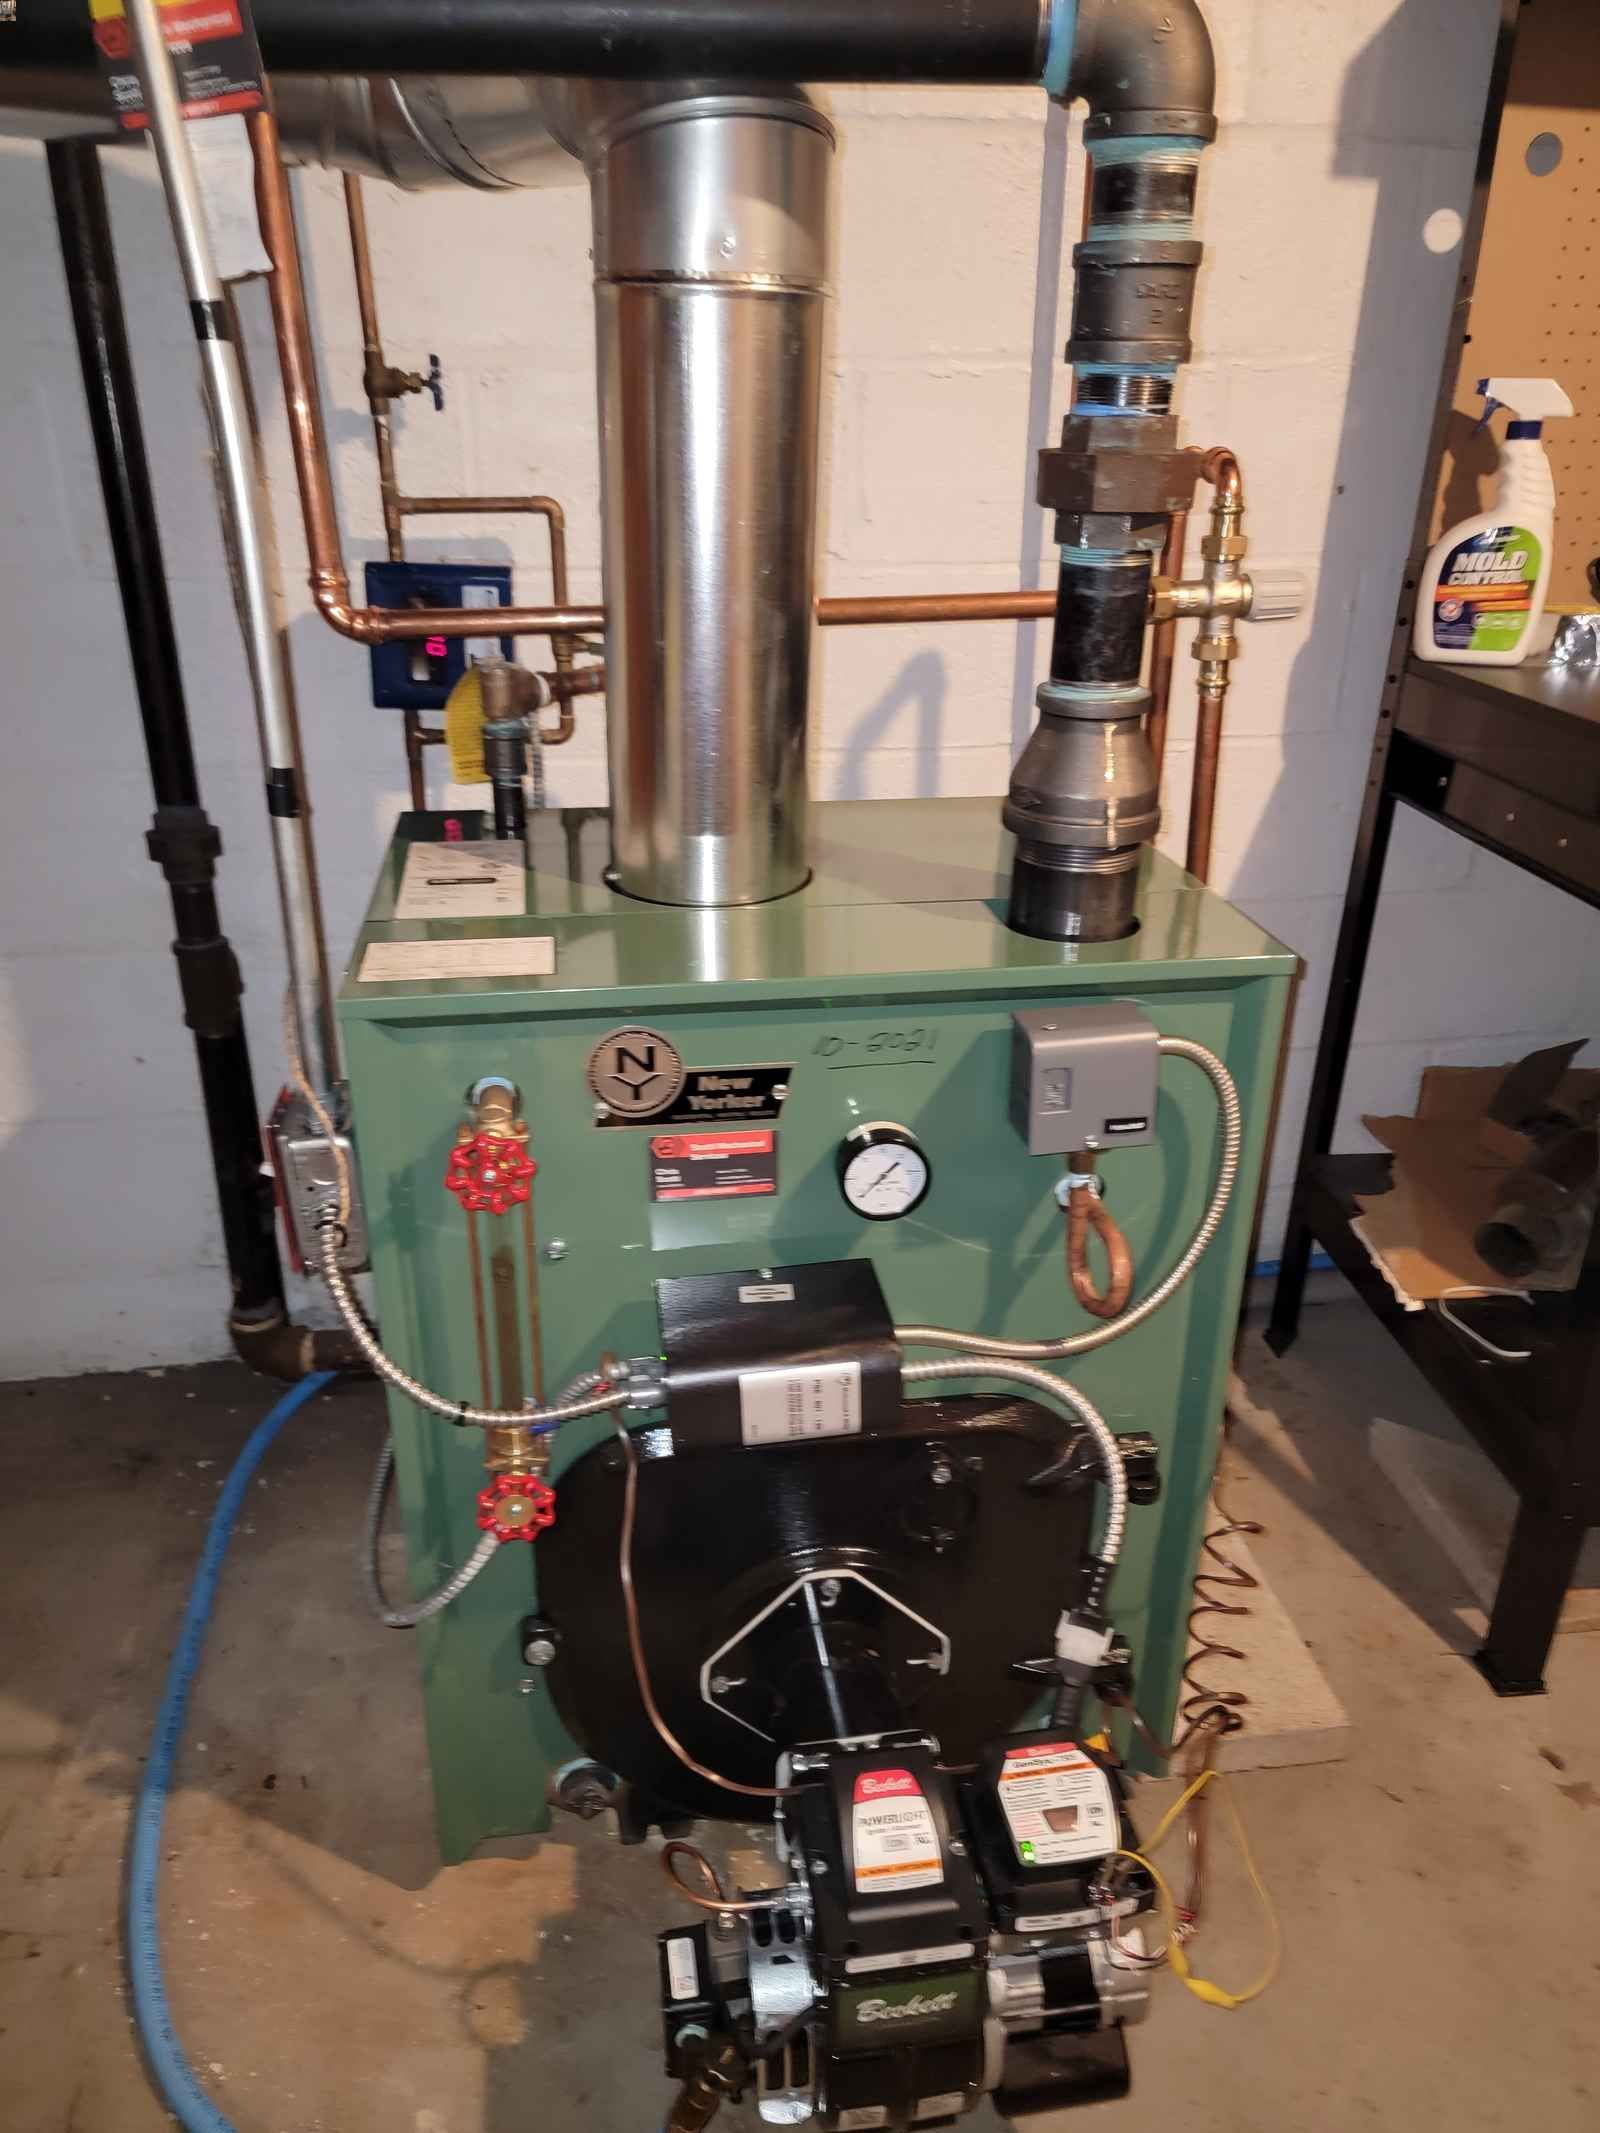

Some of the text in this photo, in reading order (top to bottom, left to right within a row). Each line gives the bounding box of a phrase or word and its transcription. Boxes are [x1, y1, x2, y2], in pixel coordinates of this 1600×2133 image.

[1452, 551, 1529, 573] MOLD
[697, 1075, 754, 1091] New
[687, 1094, 766, 1110] Yorker
[855, 1991, 958, 2022] Beckett
